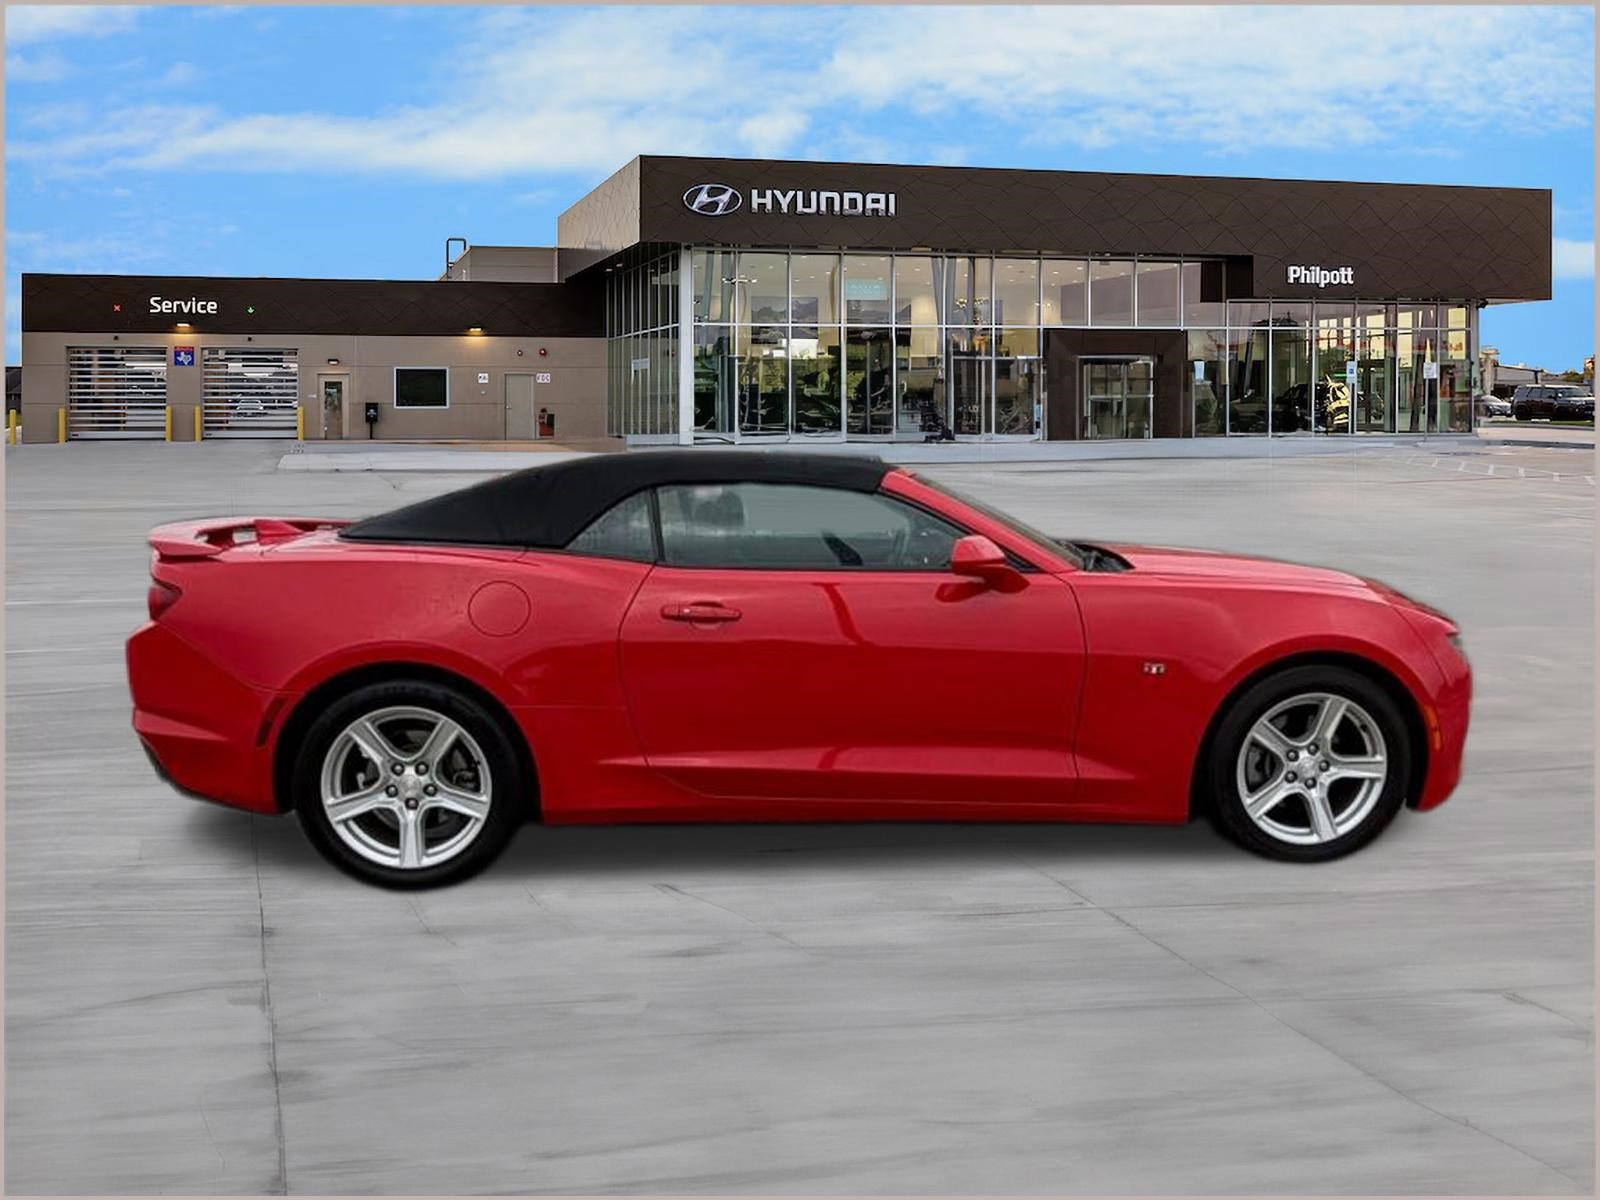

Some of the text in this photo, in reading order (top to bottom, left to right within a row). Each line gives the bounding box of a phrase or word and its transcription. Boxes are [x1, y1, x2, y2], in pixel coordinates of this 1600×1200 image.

[751, 189, 896, 216] HYUNDAI
[1287, 265, 1355, 288] Philpott
[149, 296, 218, 314] Service
